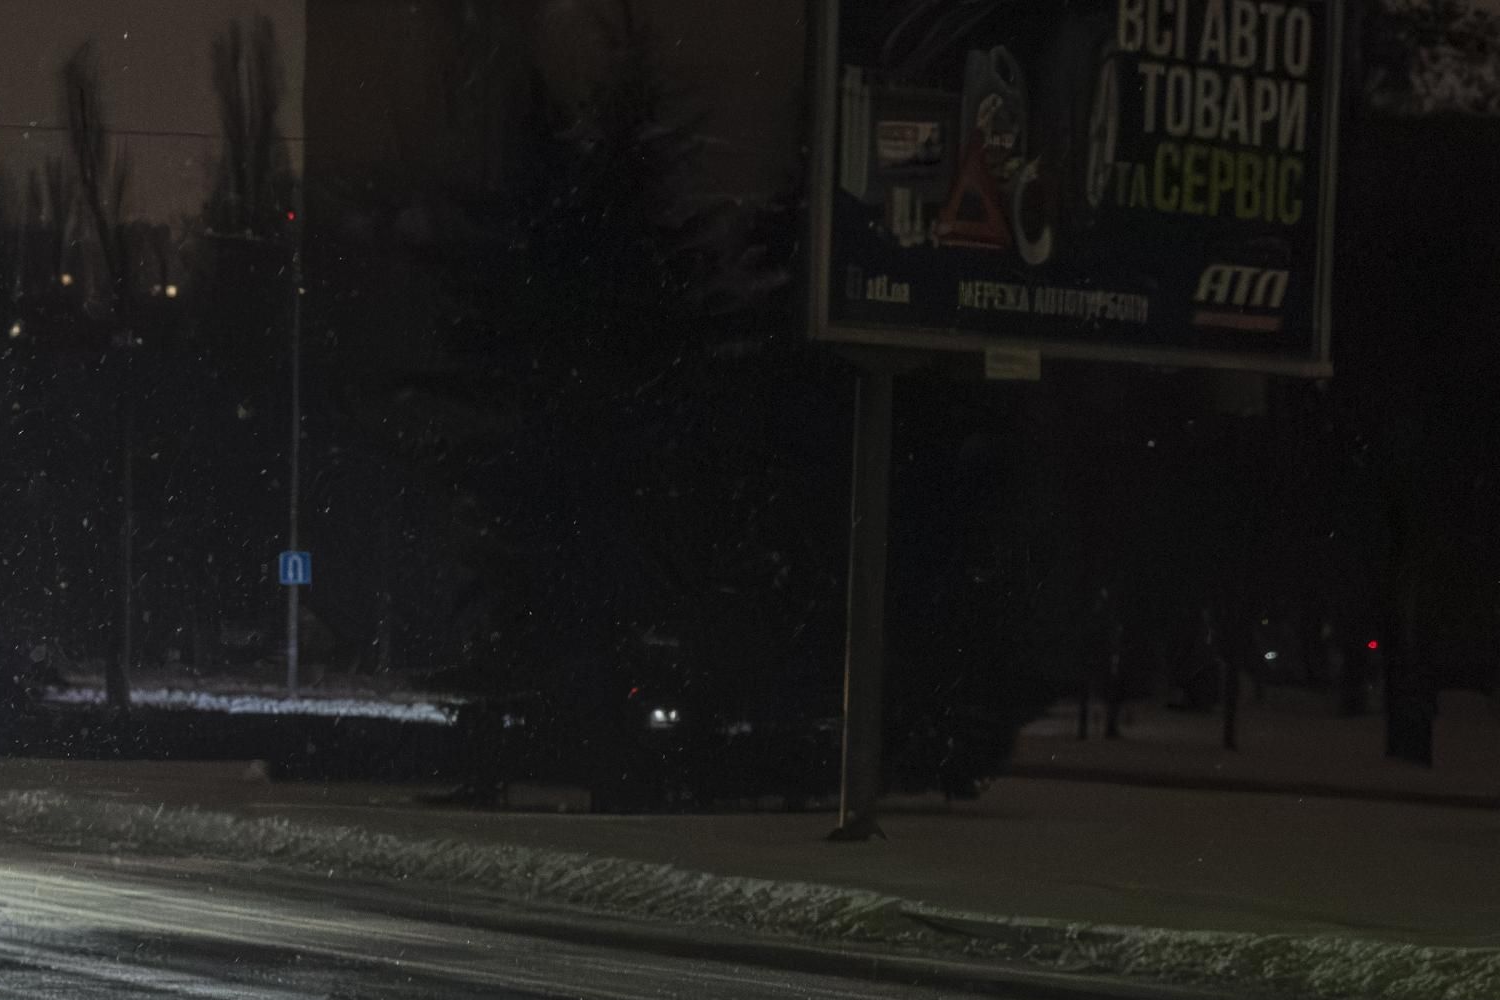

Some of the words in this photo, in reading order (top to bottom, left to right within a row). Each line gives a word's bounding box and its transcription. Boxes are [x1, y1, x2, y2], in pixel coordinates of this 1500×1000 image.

[1117, 0, 1188, 60] ВСІ
[1198, 0, 1313, 77] АВТО
[1137, 61, 1308, 151] ТОВАРИ
[1154, 143, 1304, 224] СЕРВІС
